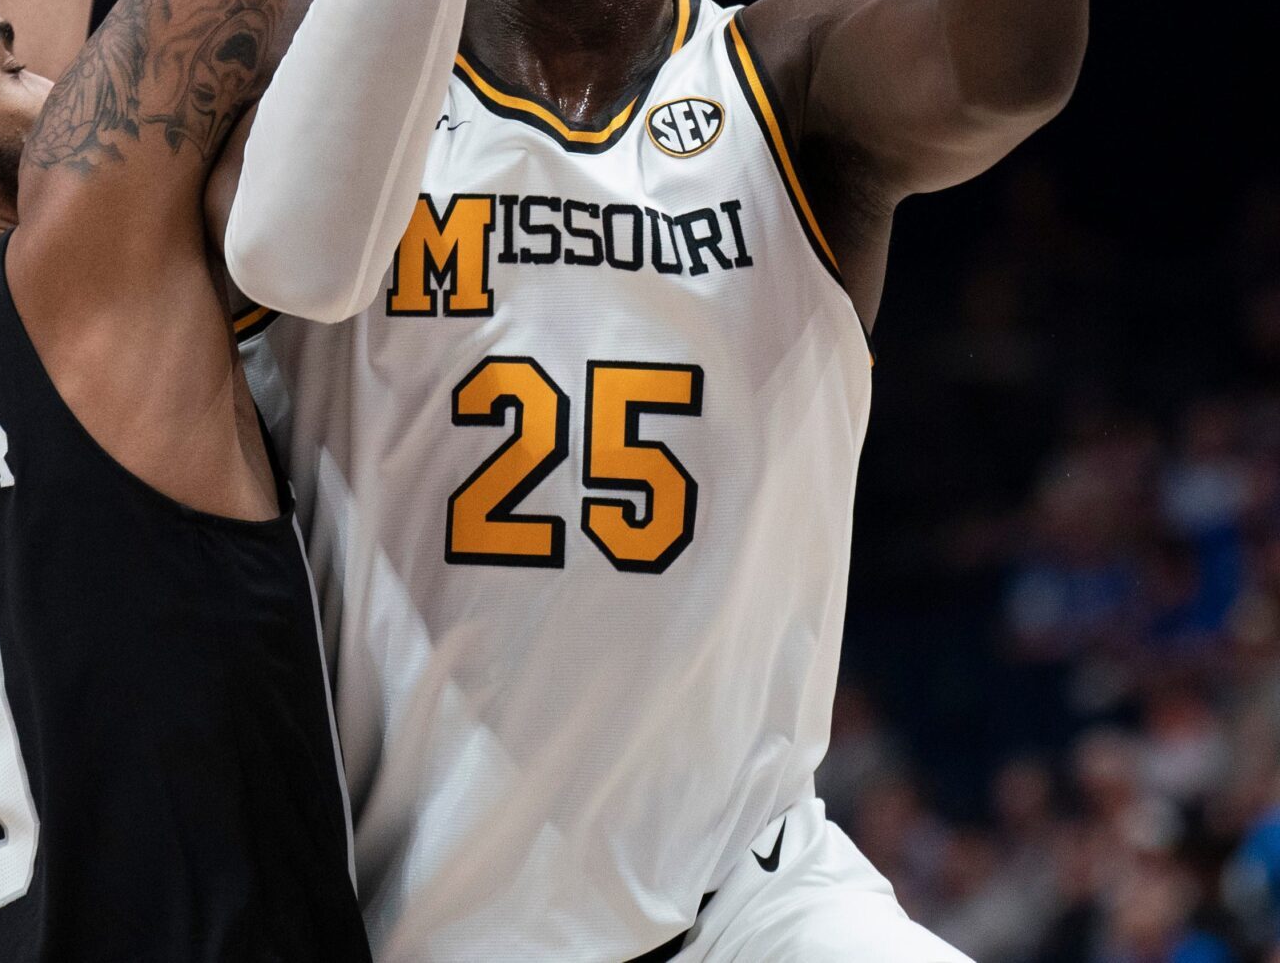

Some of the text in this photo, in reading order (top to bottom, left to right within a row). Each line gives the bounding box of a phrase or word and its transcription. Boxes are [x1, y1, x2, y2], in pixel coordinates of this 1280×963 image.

[650, 99, 721, 154] SEC
[386, 192, 754, 317] MISSOURI
[444, 355, 705, 575] 25
